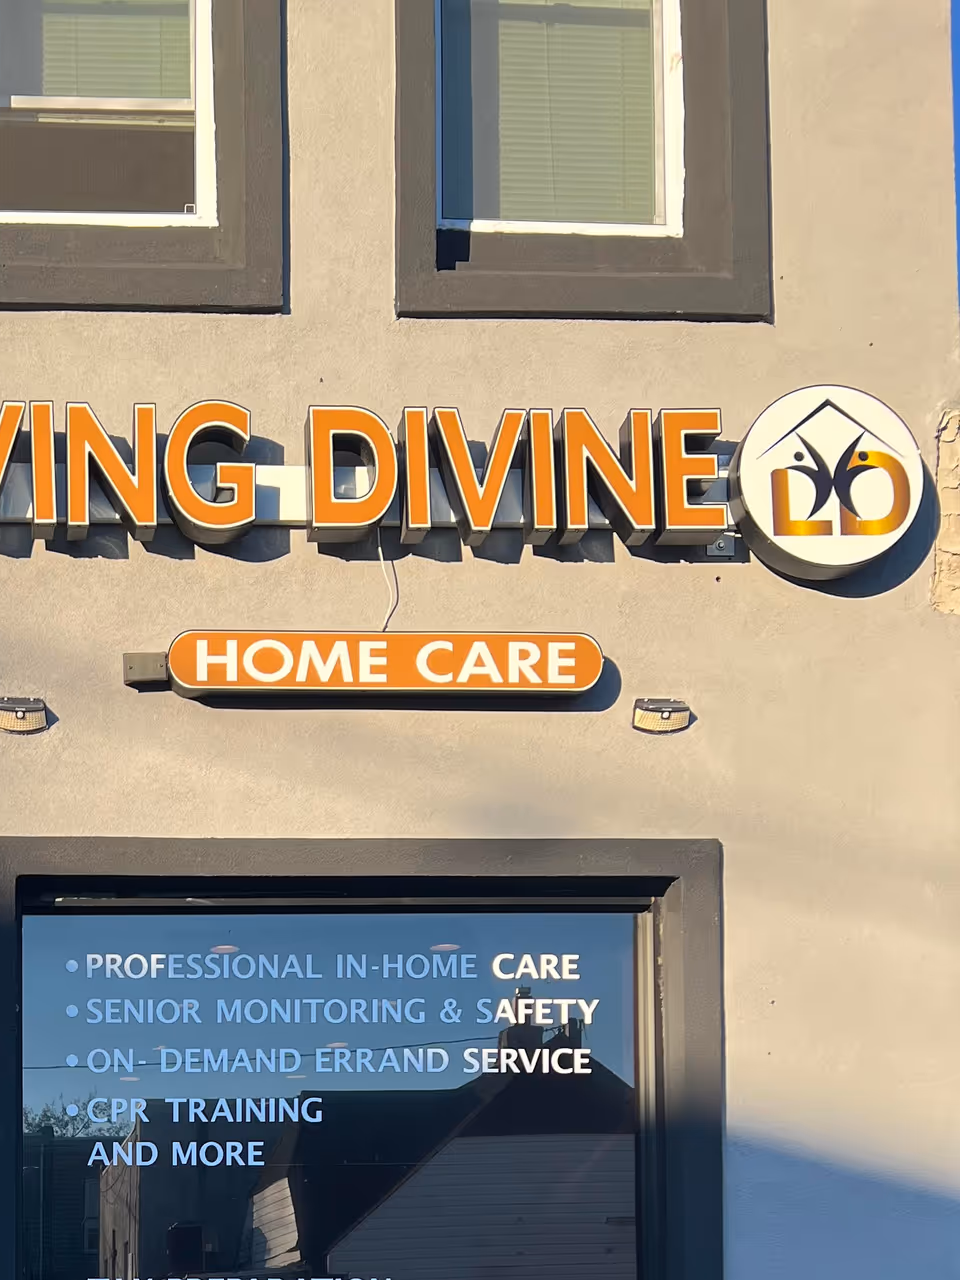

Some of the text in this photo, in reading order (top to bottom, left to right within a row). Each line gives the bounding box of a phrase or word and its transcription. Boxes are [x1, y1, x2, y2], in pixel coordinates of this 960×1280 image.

[307, 404, 730, 532] DIVINE
[195, 638, 578, 685] HOME CARE
[86, 952, 581, 980] PROFESSIONAL IN-HOME CARE
[86, 998, 601, 1026] SENIOR MONITORING & SAFETY
[86, 1047, 592, 1074] ON- DEMAND ERRAND SERVICE
[86, 1097, 323, 1124] CPR TRAINING
[87, 1141, 265, 1168] AND MORE
